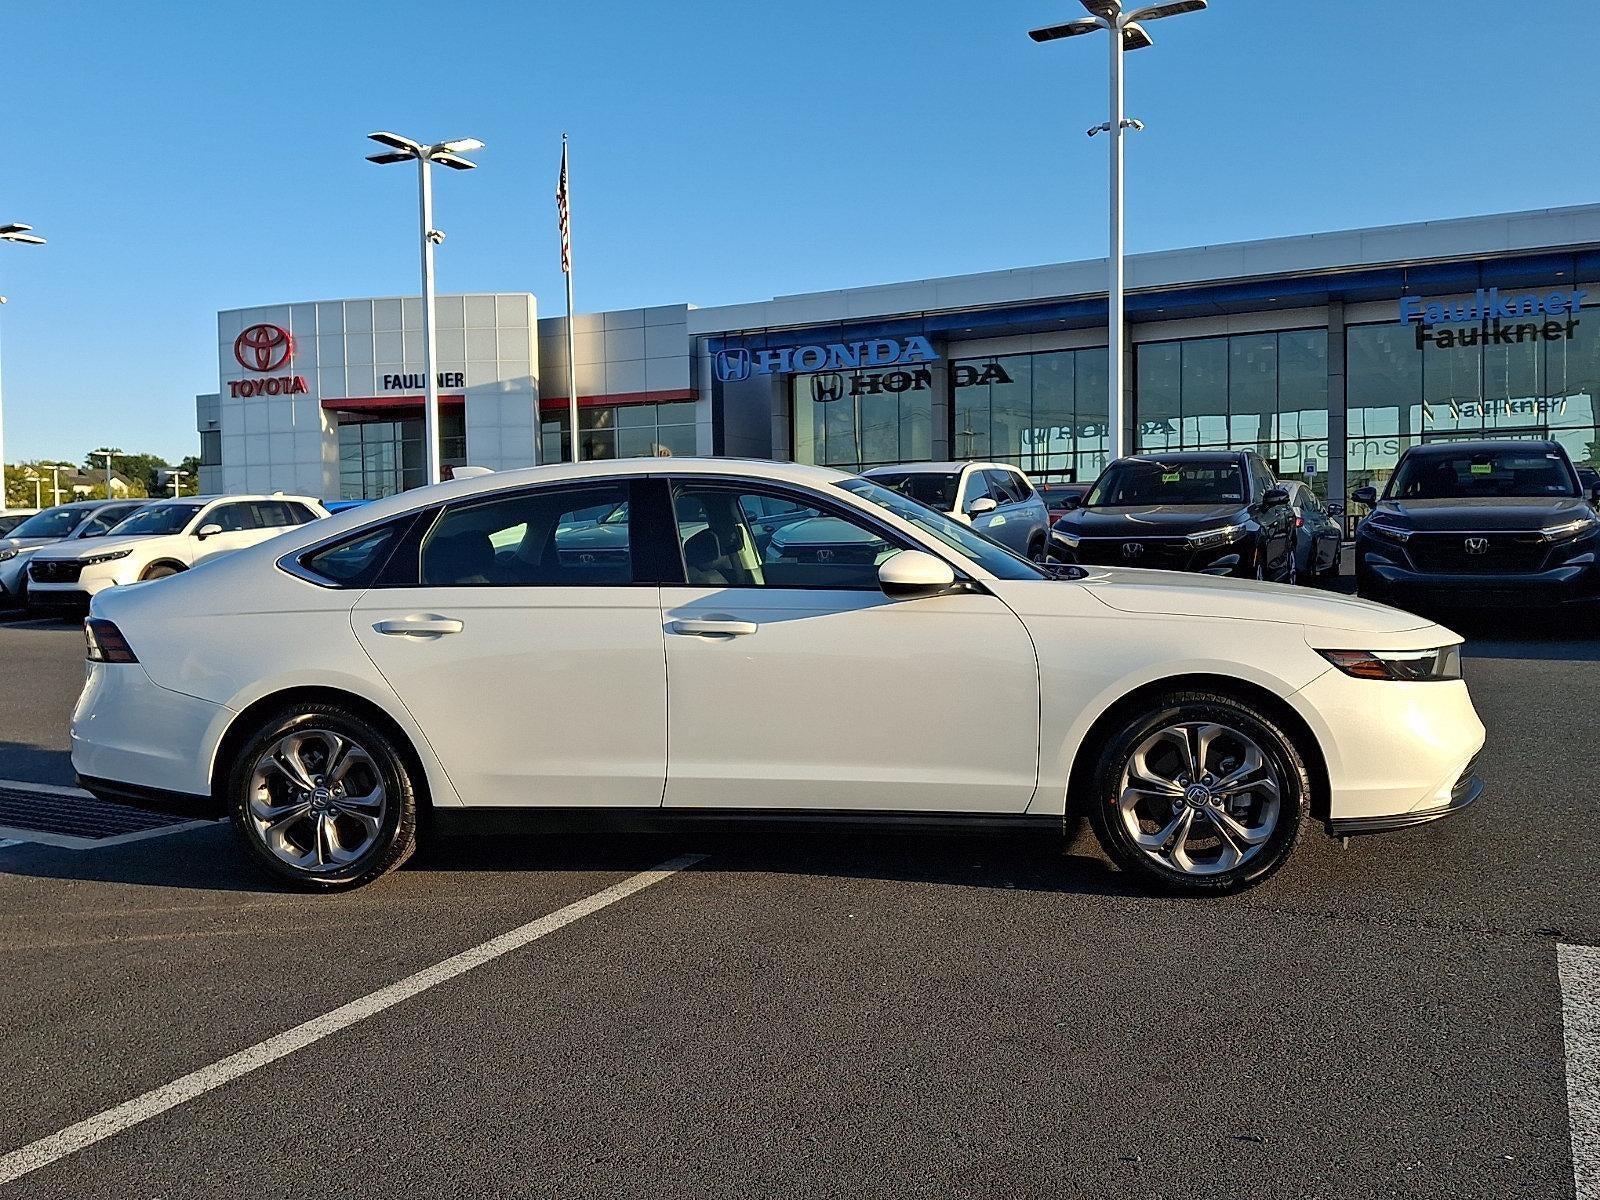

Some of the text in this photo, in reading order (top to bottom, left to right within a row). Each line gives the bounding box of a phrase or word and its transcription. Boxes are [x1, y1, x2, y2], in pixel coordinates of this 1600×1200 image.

[1398, 287, 1588, 326] Faulkner
[1415, 314, 1580, 349] Faulkner
[756, 335, 940, 374] HONDA
[227, 376, 308, 398] TOYOTA
[1281, 440, 1399, 459] Drems
